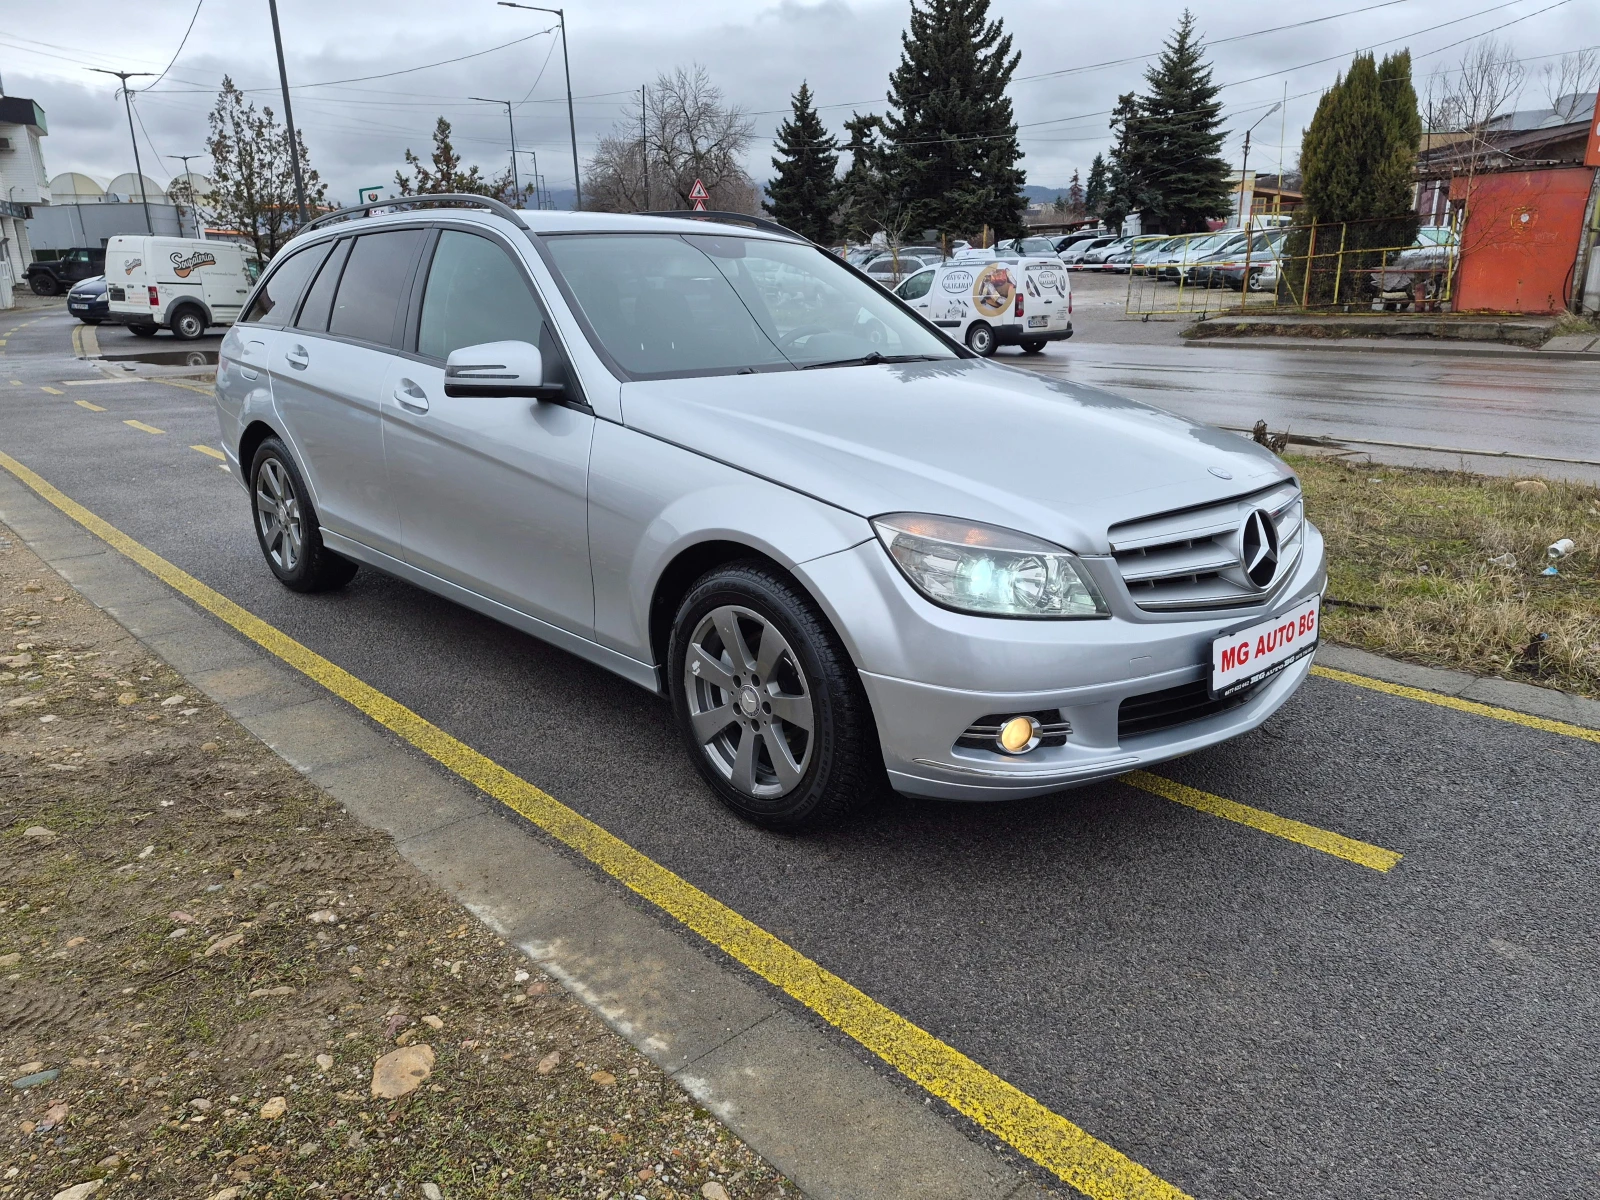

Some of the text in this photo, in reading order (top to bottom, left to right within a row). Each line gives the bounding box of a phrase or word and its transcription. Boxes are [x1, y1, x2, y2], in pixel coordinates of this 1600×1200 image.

[170, 251, 215, 271] Soupateria
[1221, 609, 1315, 673] MG AUTO BG
